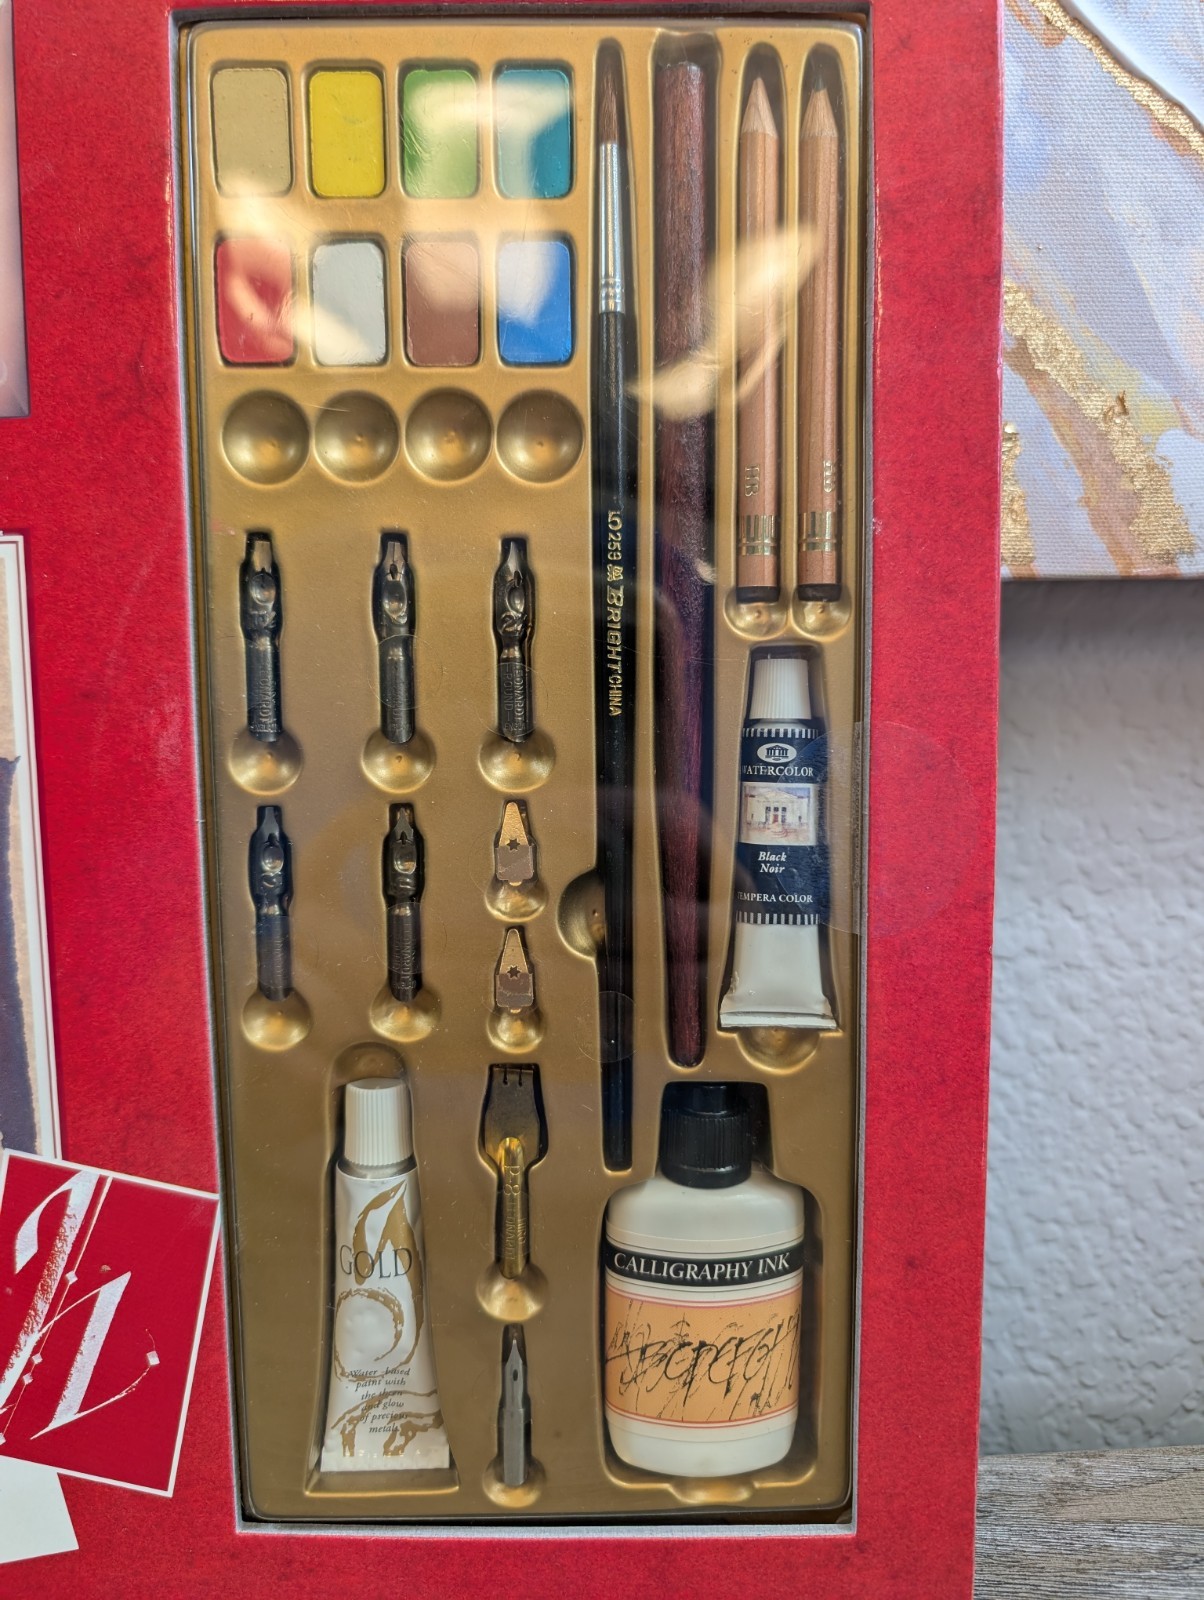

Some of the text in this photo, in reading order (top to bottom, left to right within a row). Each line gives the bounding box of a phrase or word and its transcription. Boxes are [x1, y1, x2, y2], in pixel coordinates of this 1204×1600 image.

[606, 585, 624, 673] BRIGHT
[608, 674, 623, 717] CHINA
[757, 851, 787, 862] Black
[759, 863, 785, 874] Noir
[778, 893, 813, 903] COLOR
[339, 1245, 413, 1279] GOLD
[614, 1252, 790, 1280] CALLIGRAPHY INK
[354, 1377, 407, 1392] paint with
[360, 1390, 376, 1401] the
[382, 1398, 405, 1410] glow
[359, 1412, 371, 1424] of
